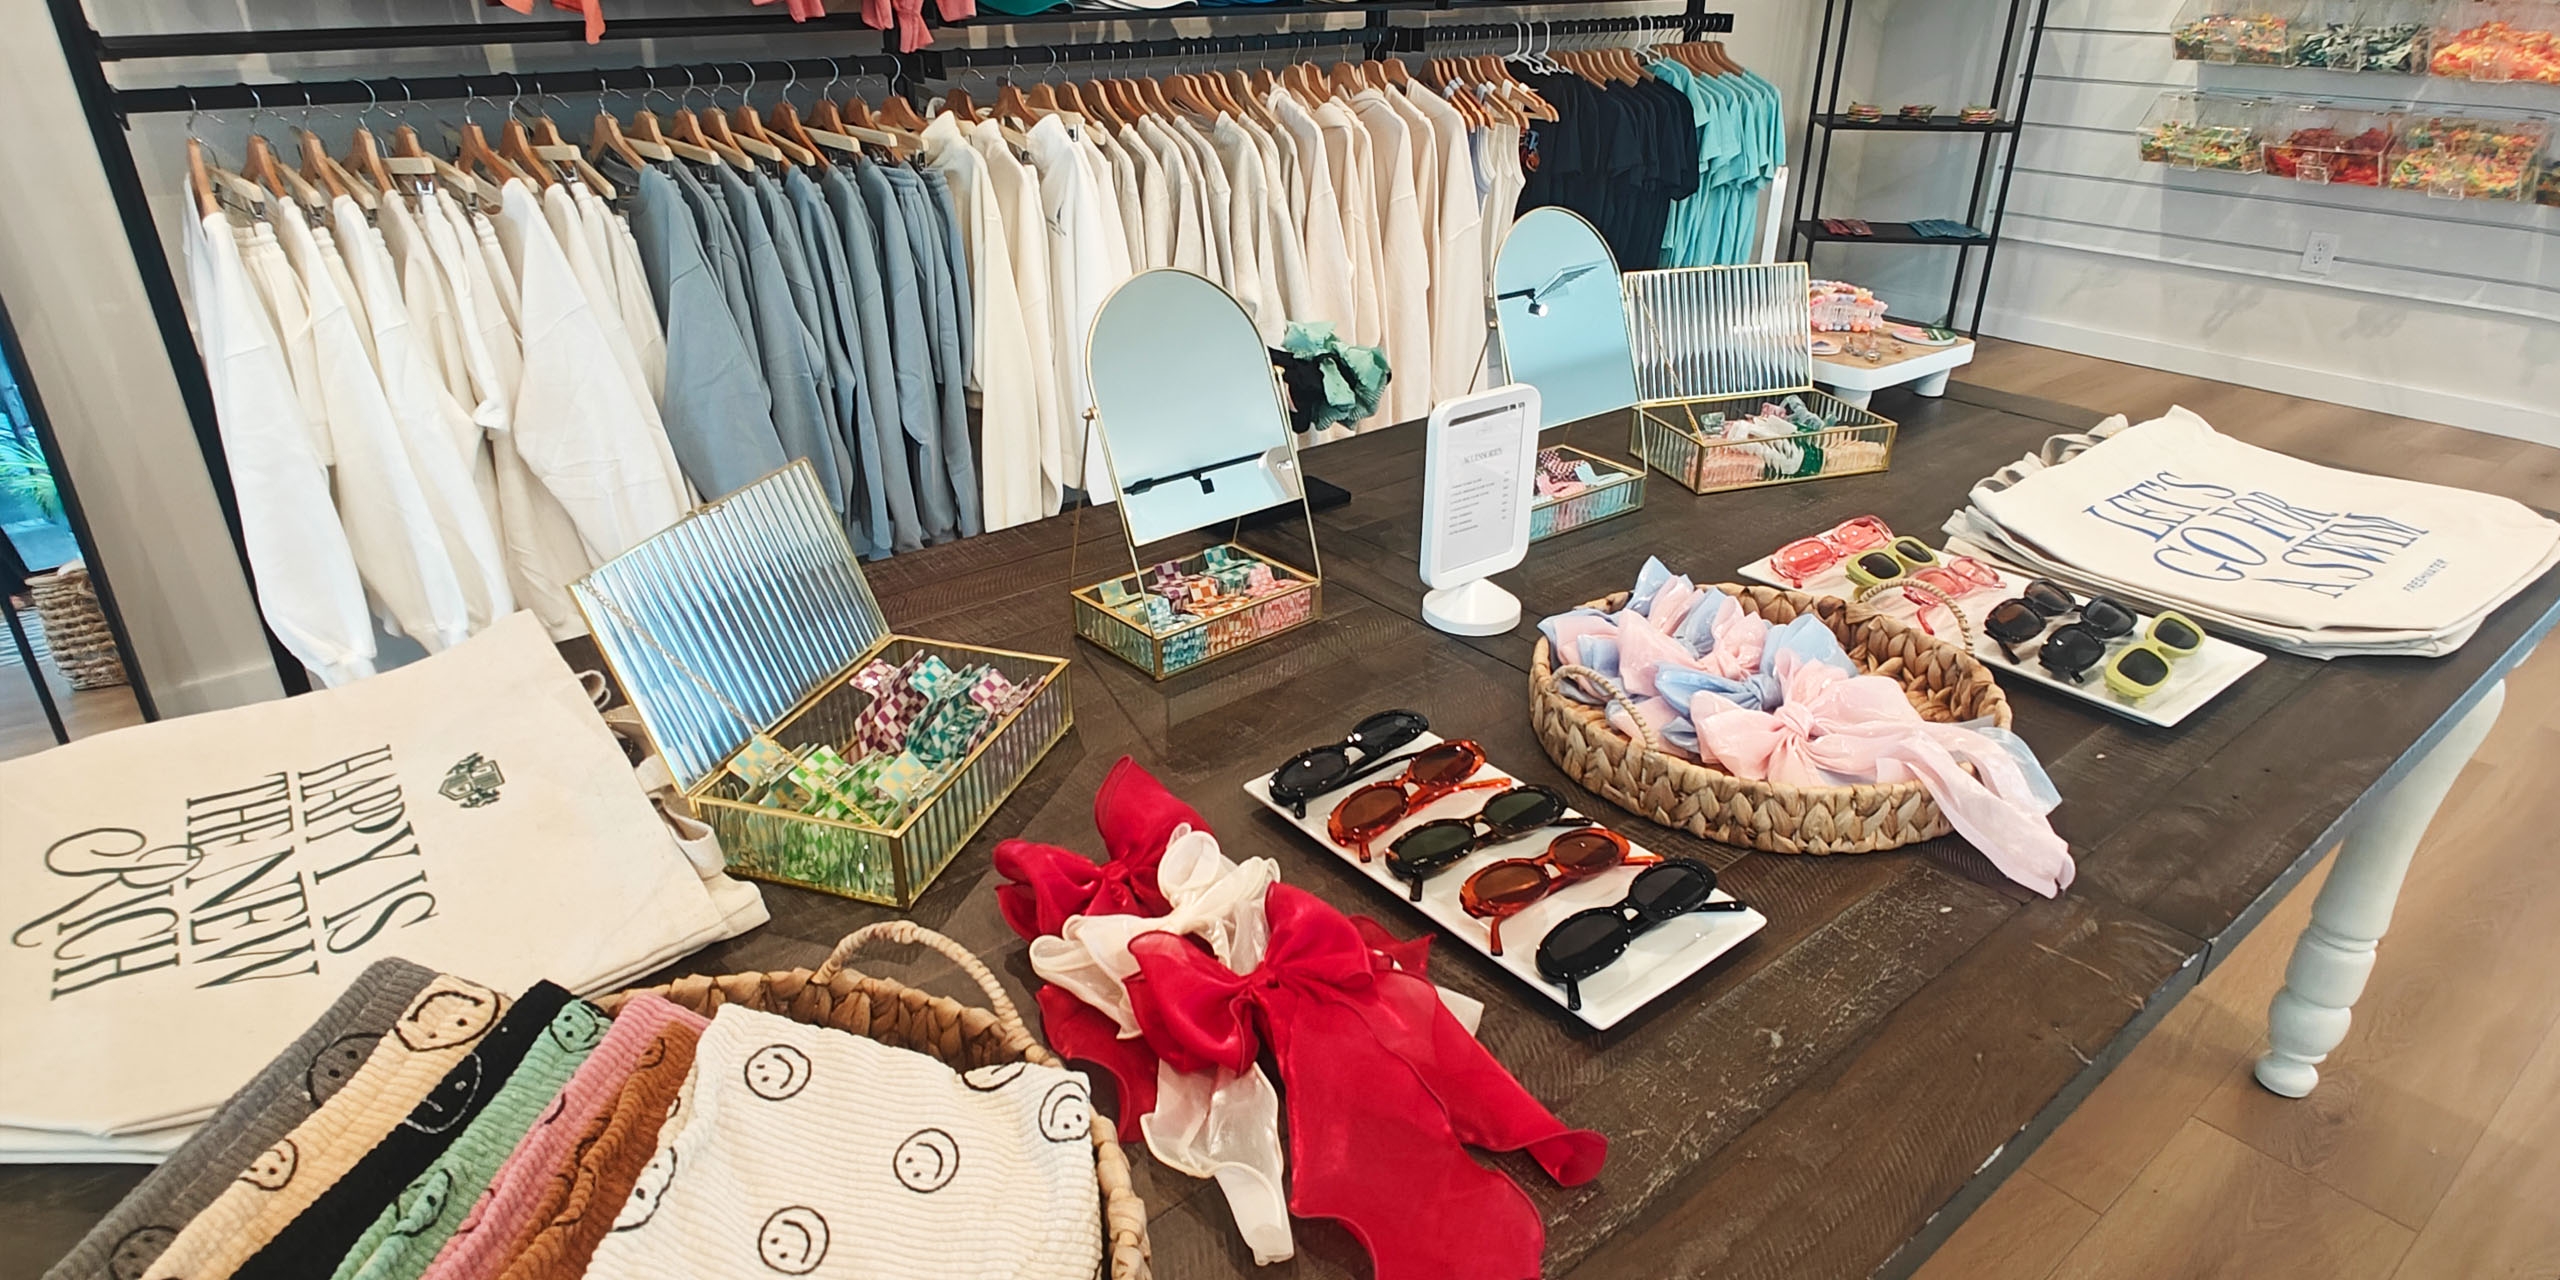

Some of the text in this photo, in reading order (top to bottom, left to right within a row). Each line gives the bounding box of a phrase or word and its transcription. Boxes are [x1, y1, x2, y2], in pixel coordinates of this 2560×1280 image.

[2082, 470, 2236, 543] LET'S
[2153, 491, 2339, 582] GO FOR
[2251, 512, 2430, 599] A SWIM
[11, 827, 205, 1001] RICH
[186, 771, 320, 990] THE NEW
[298, 744, 439, 955] HAPPY IS
